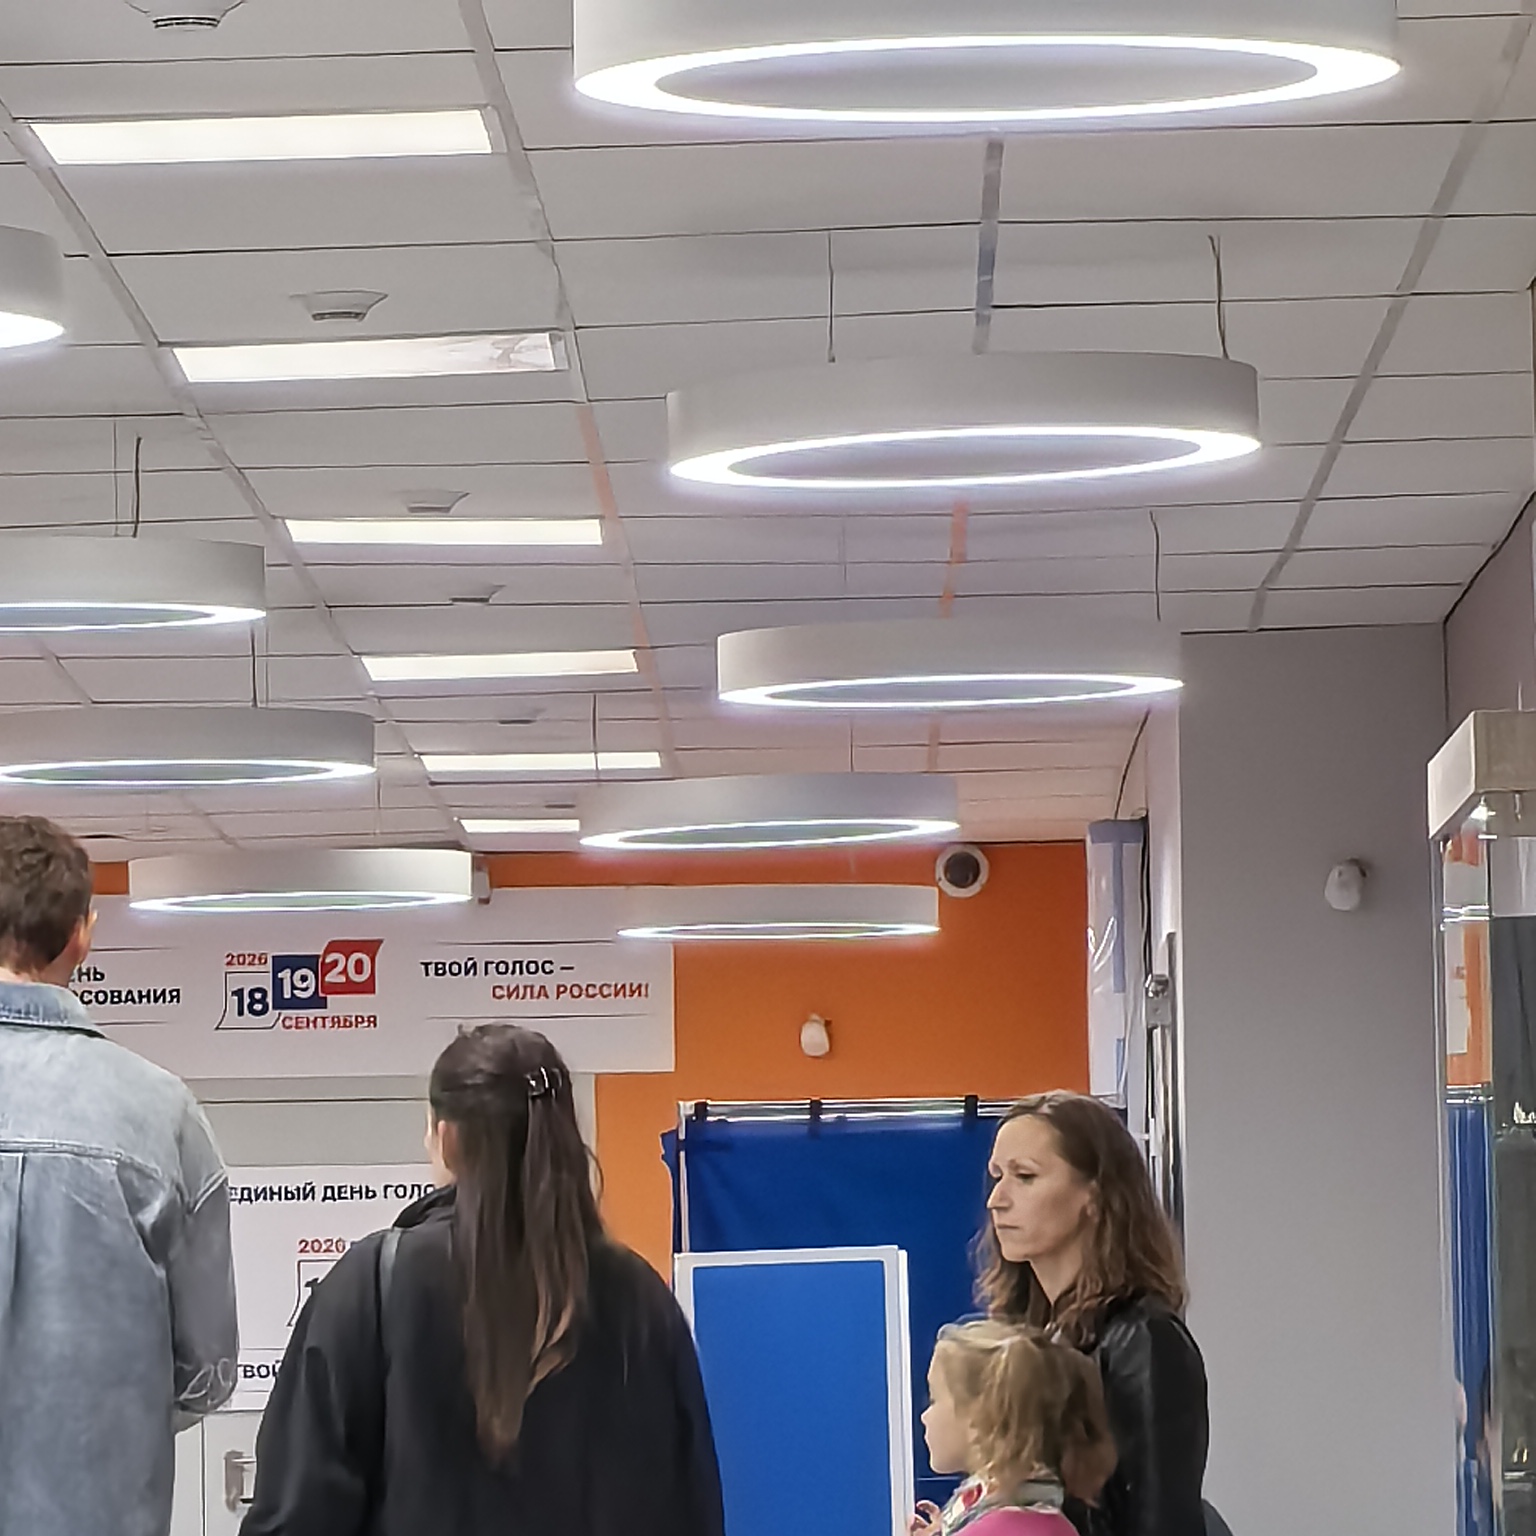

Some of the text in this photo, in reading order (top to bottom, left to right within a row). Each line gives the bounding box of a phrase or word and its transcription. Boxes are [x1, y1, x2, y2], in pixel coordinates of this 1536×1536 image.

[70, 966, 105, 982] НЬ
[324, 952, 372, 983] 20
[420, 957, 478, 977] ТВОЙ
[484, 960, 554, 976] ГОЛОС
[277, 968, 315, 999] 19
[492, 983, 649, 1000] СИЛА РОССИИ!
[72, 988, 181, 1006] СОВАНИЯ
[230, 987, 270, 1017] 18
[281, 1014, 377, 1031] СЕНТЯБРЯ
[322, 1184, 377, 1203] ДЕНЬ
